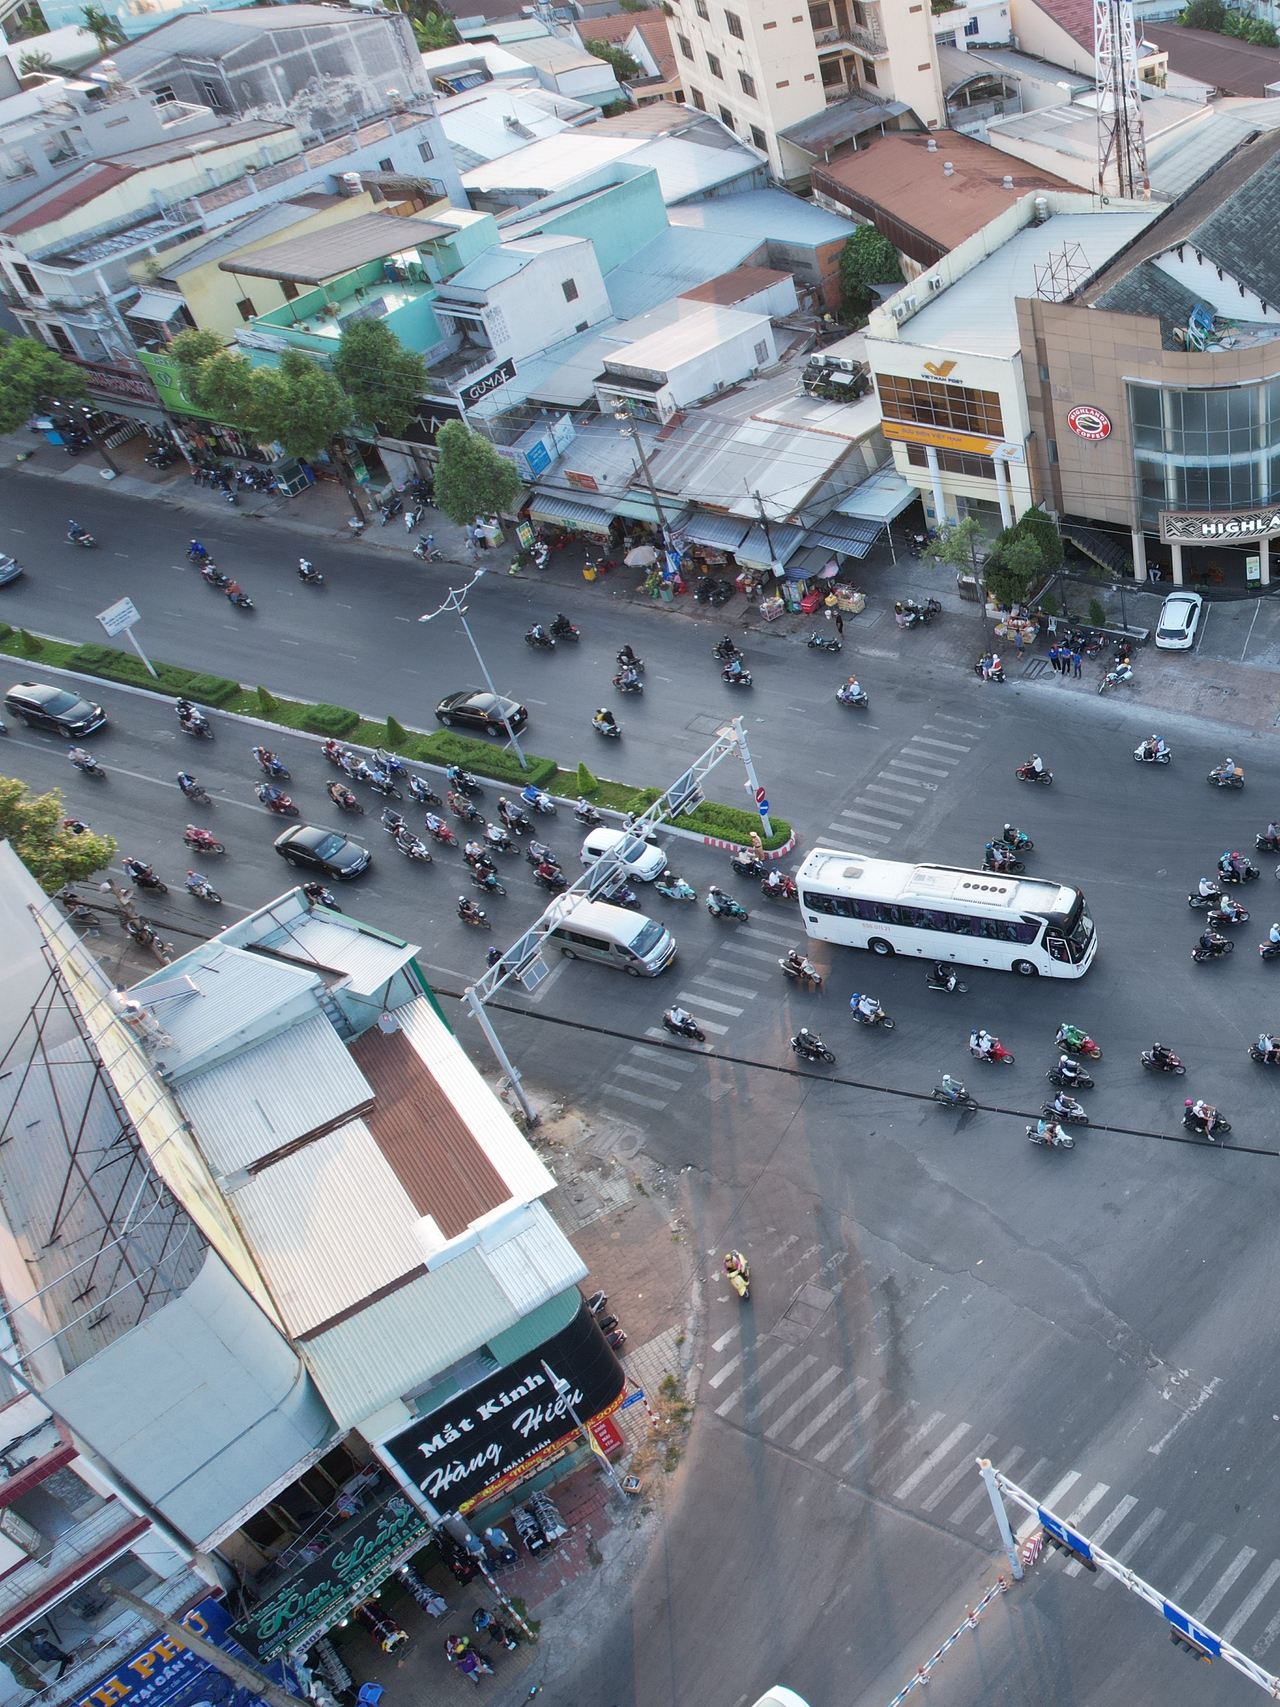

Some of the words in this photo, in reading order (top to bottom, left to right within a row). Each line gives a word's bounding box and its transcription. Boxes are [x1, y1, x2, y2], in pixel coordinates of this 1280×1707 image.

[921, 373, 947, 383] VIETNAM
[1070, 408, 1108, 425] HIGHLANDS
[1076, 428, 1105, 439] COFFEE
[947, 435, 962, 443] NAM
[418, 1417, 474, 1459] Mắt
[419, 1443, 503, 1498] Hàng
[511, 1388, 584, 1438] Hiệu
[483, 1472, 501, 1487] 127
[503, 1456, 525, 1474] MẬU
[525, 1438, 552, 1458] THÂN
[365, 1543, 391, 1569] Trang
[256, 1579, 331, 1640] Kim
[331, 1511, 410, 1579] Loan
[295, 1629, 323, 1654] SHOP
[326, 1601, 353, 1628] KIM
[355, 1568, 393, 1600] LOAN
[264, 1645, 282, 1662] 125
[129, 1682, 156, 1705] TẠI
[154, 1660, 186, 1687] CẦN
